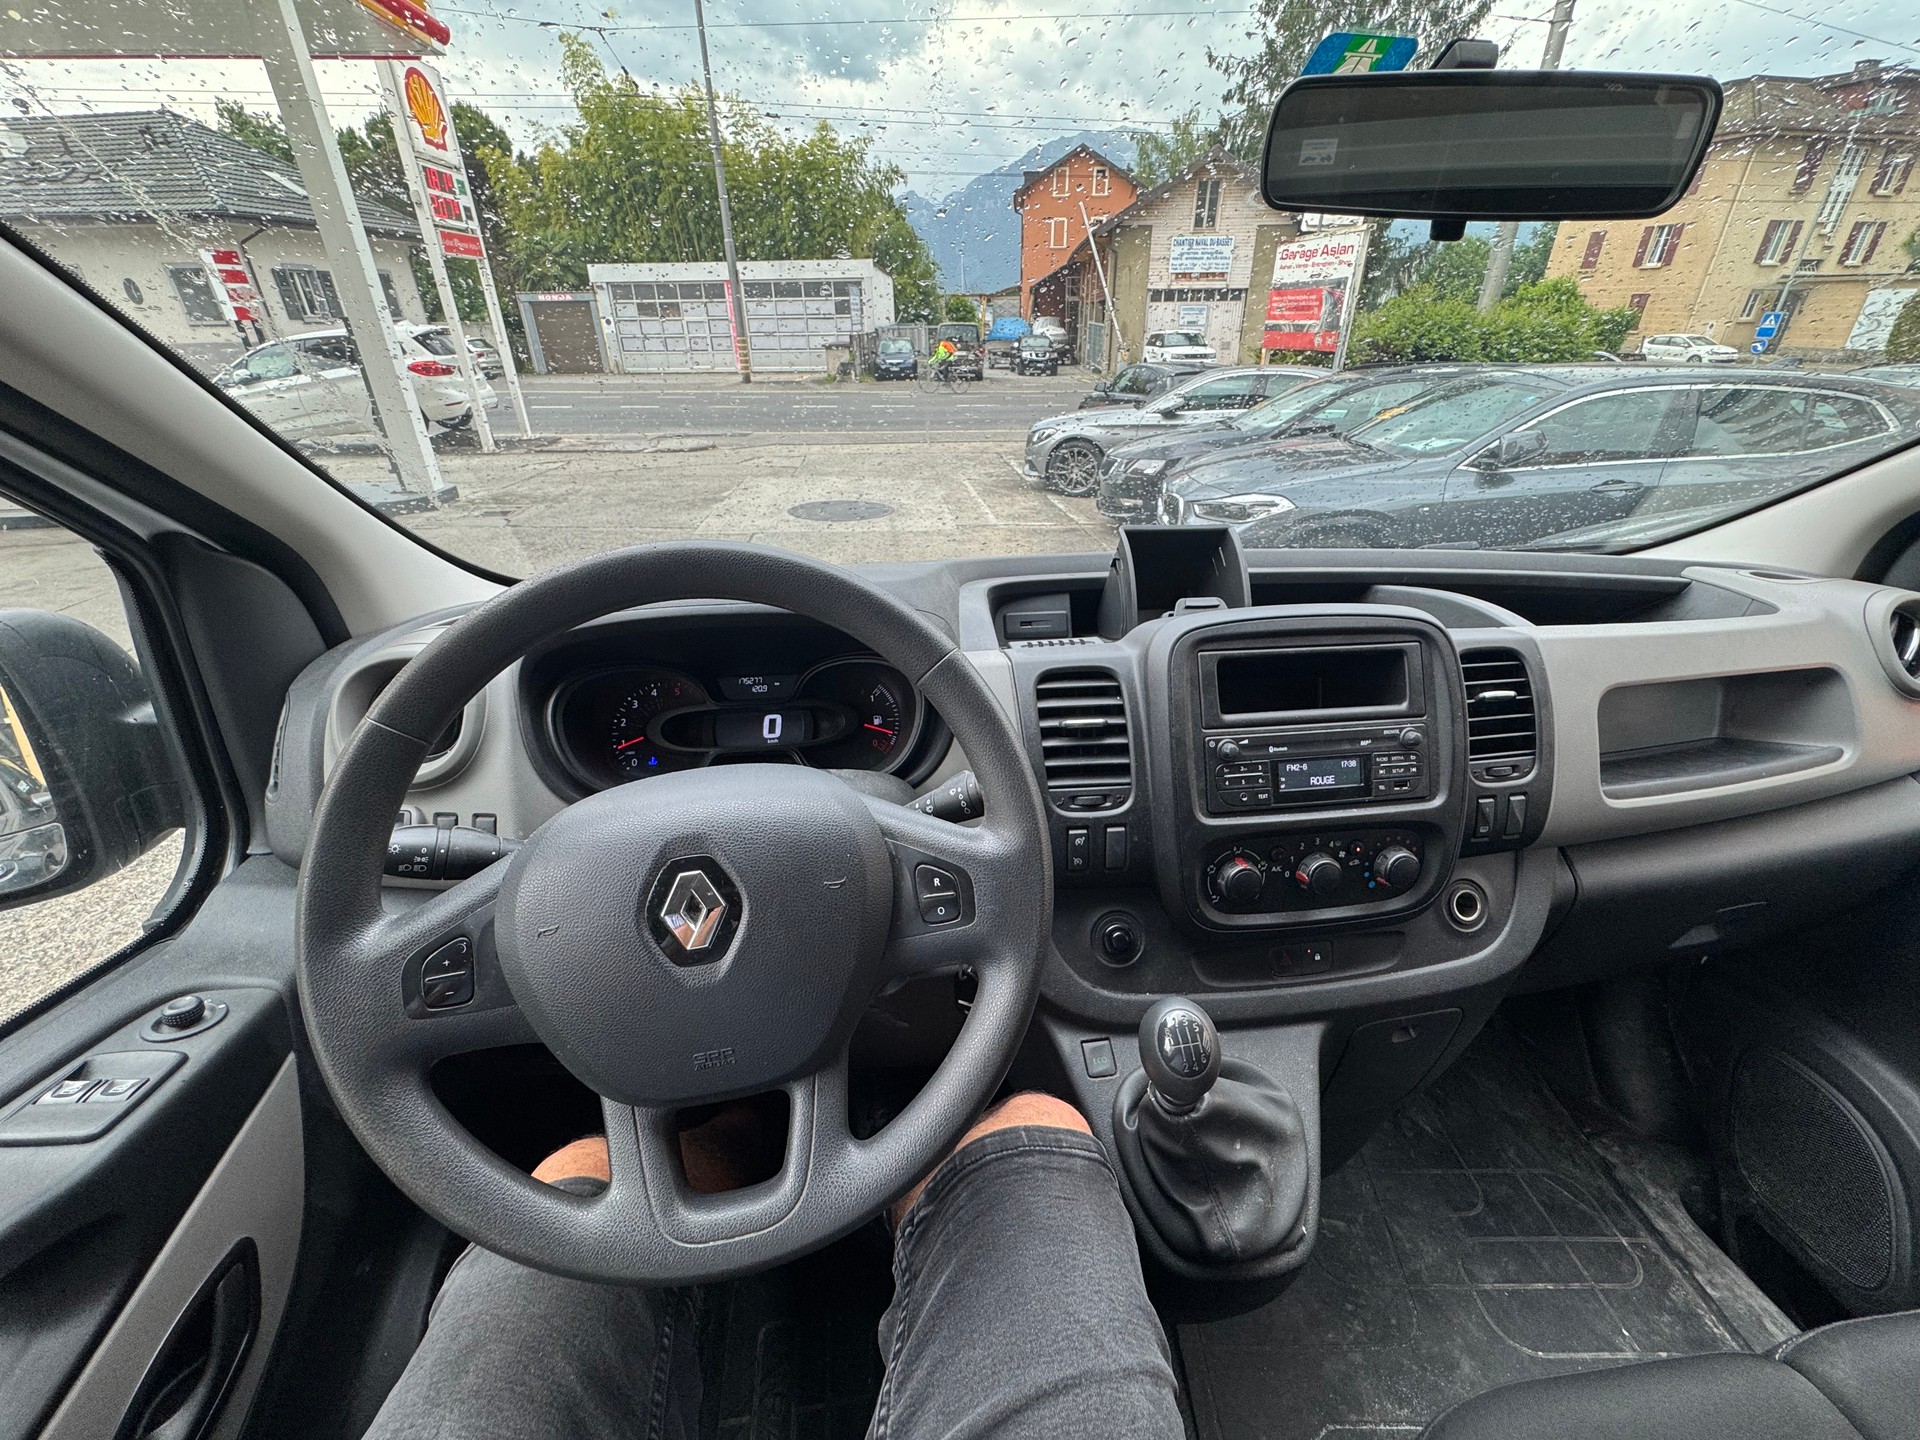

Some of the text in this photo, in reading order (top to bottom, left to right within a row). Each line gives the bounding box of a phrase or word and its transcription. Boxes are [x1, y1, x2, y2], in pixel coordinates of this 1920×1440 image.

[1280, 243, 1355, 262] Garage Aslan
[632, 700, 638, 708] 3
[620, 718, 626, 726] 2
[762, 714, 782, 738] 0
[1310, 775, 1335, 785] ROUGE
[934, 878, 941, 886] R
[1181, 1015, 1188, 1026] 3
[1192, 1022, 1199, 1032] 5
[1092, 1056, 1108, 1065] ECO
[1201, 1055, 1207, 1063] 6
[1182, 1064, 1199, 1072] 2 4
